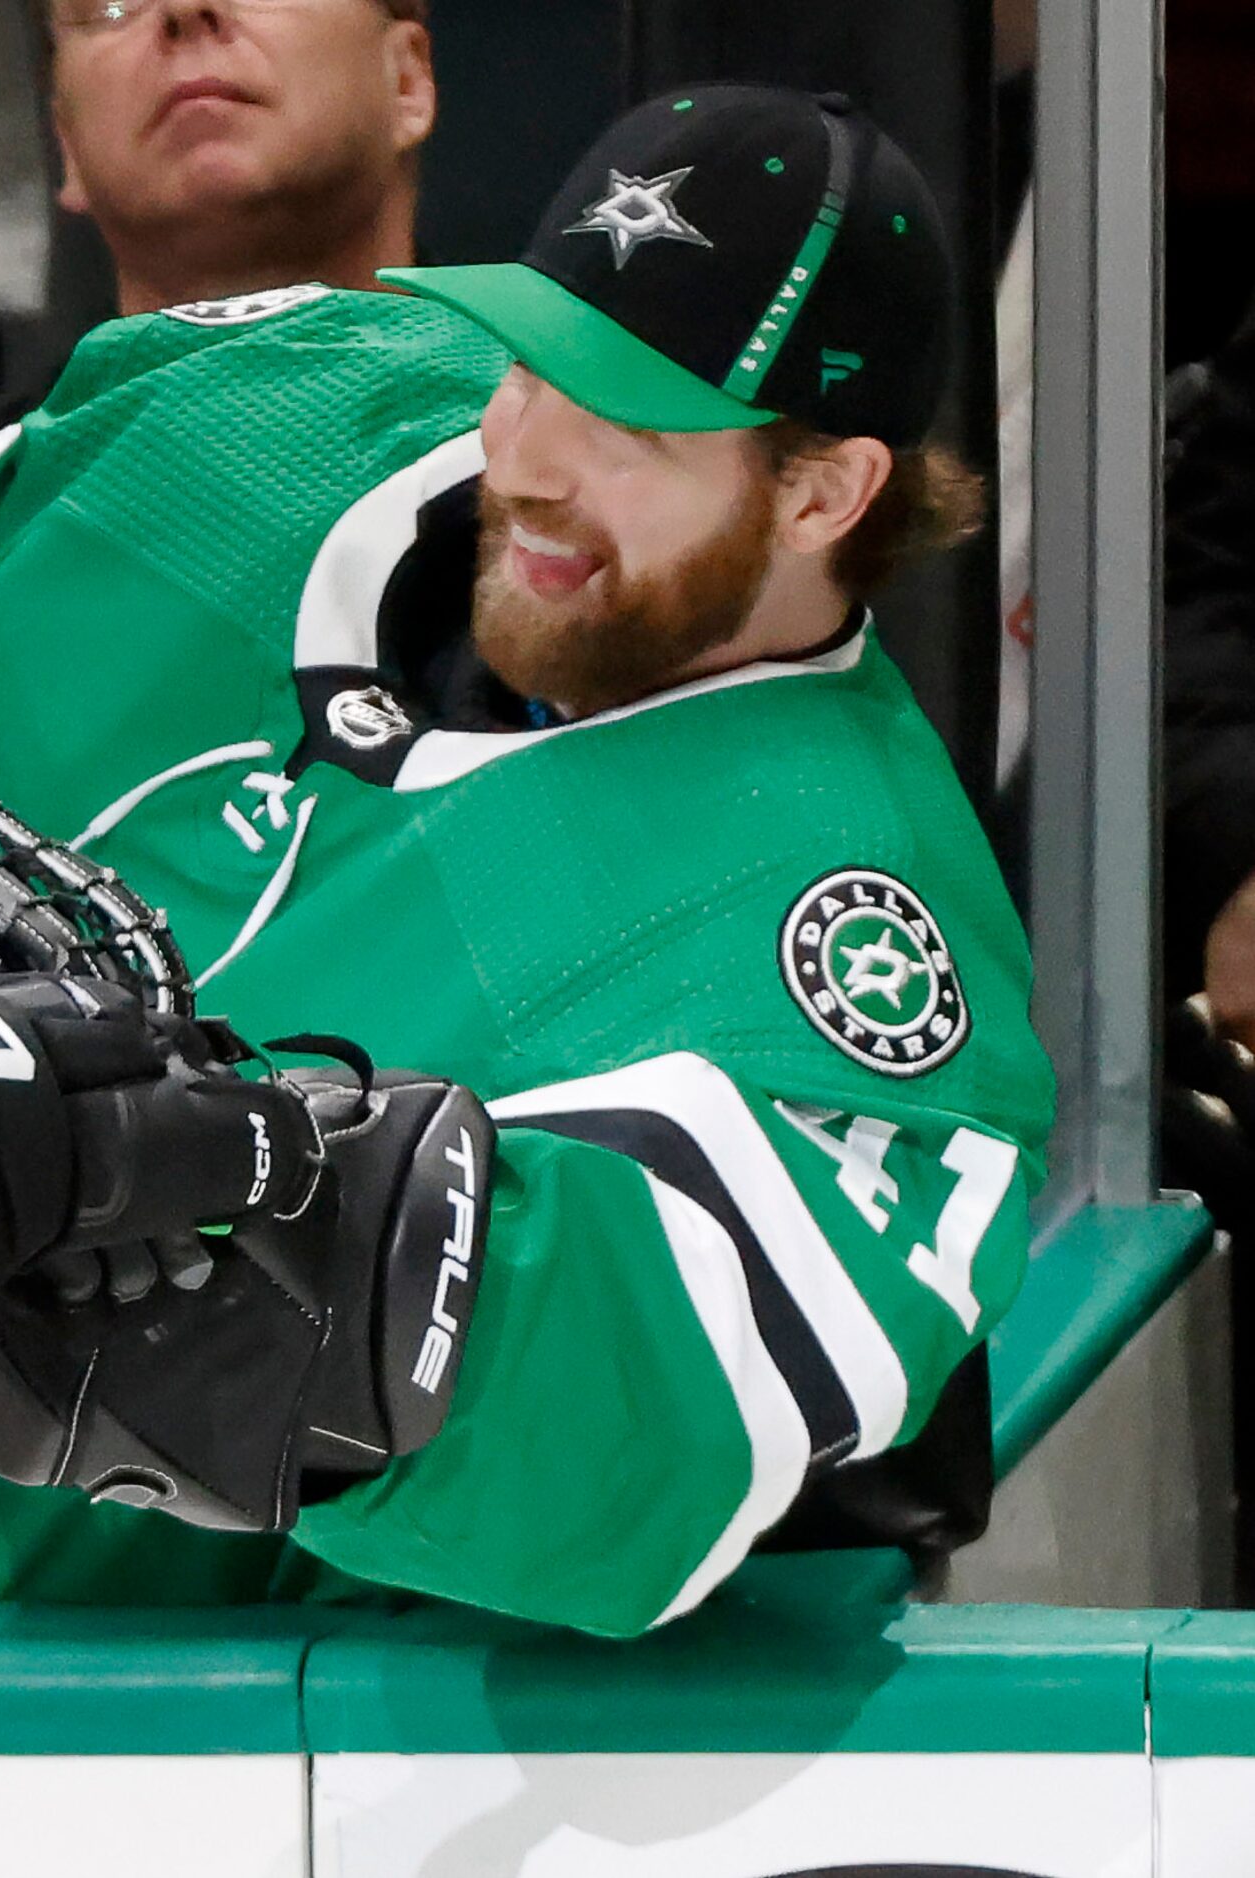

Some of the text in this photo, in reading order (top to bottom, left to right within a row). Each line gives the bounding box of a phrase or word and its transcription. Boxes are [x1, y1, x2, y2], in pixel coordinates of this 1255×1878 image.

[740, 266, 809, 372] DALLAS
[797, 883, 951, 976] DALLAS
[812, 988, 954, 1060] STARS
[245, 1111, 272, 1206] CCM
[410, 1125, 477, 1395] TRUE
